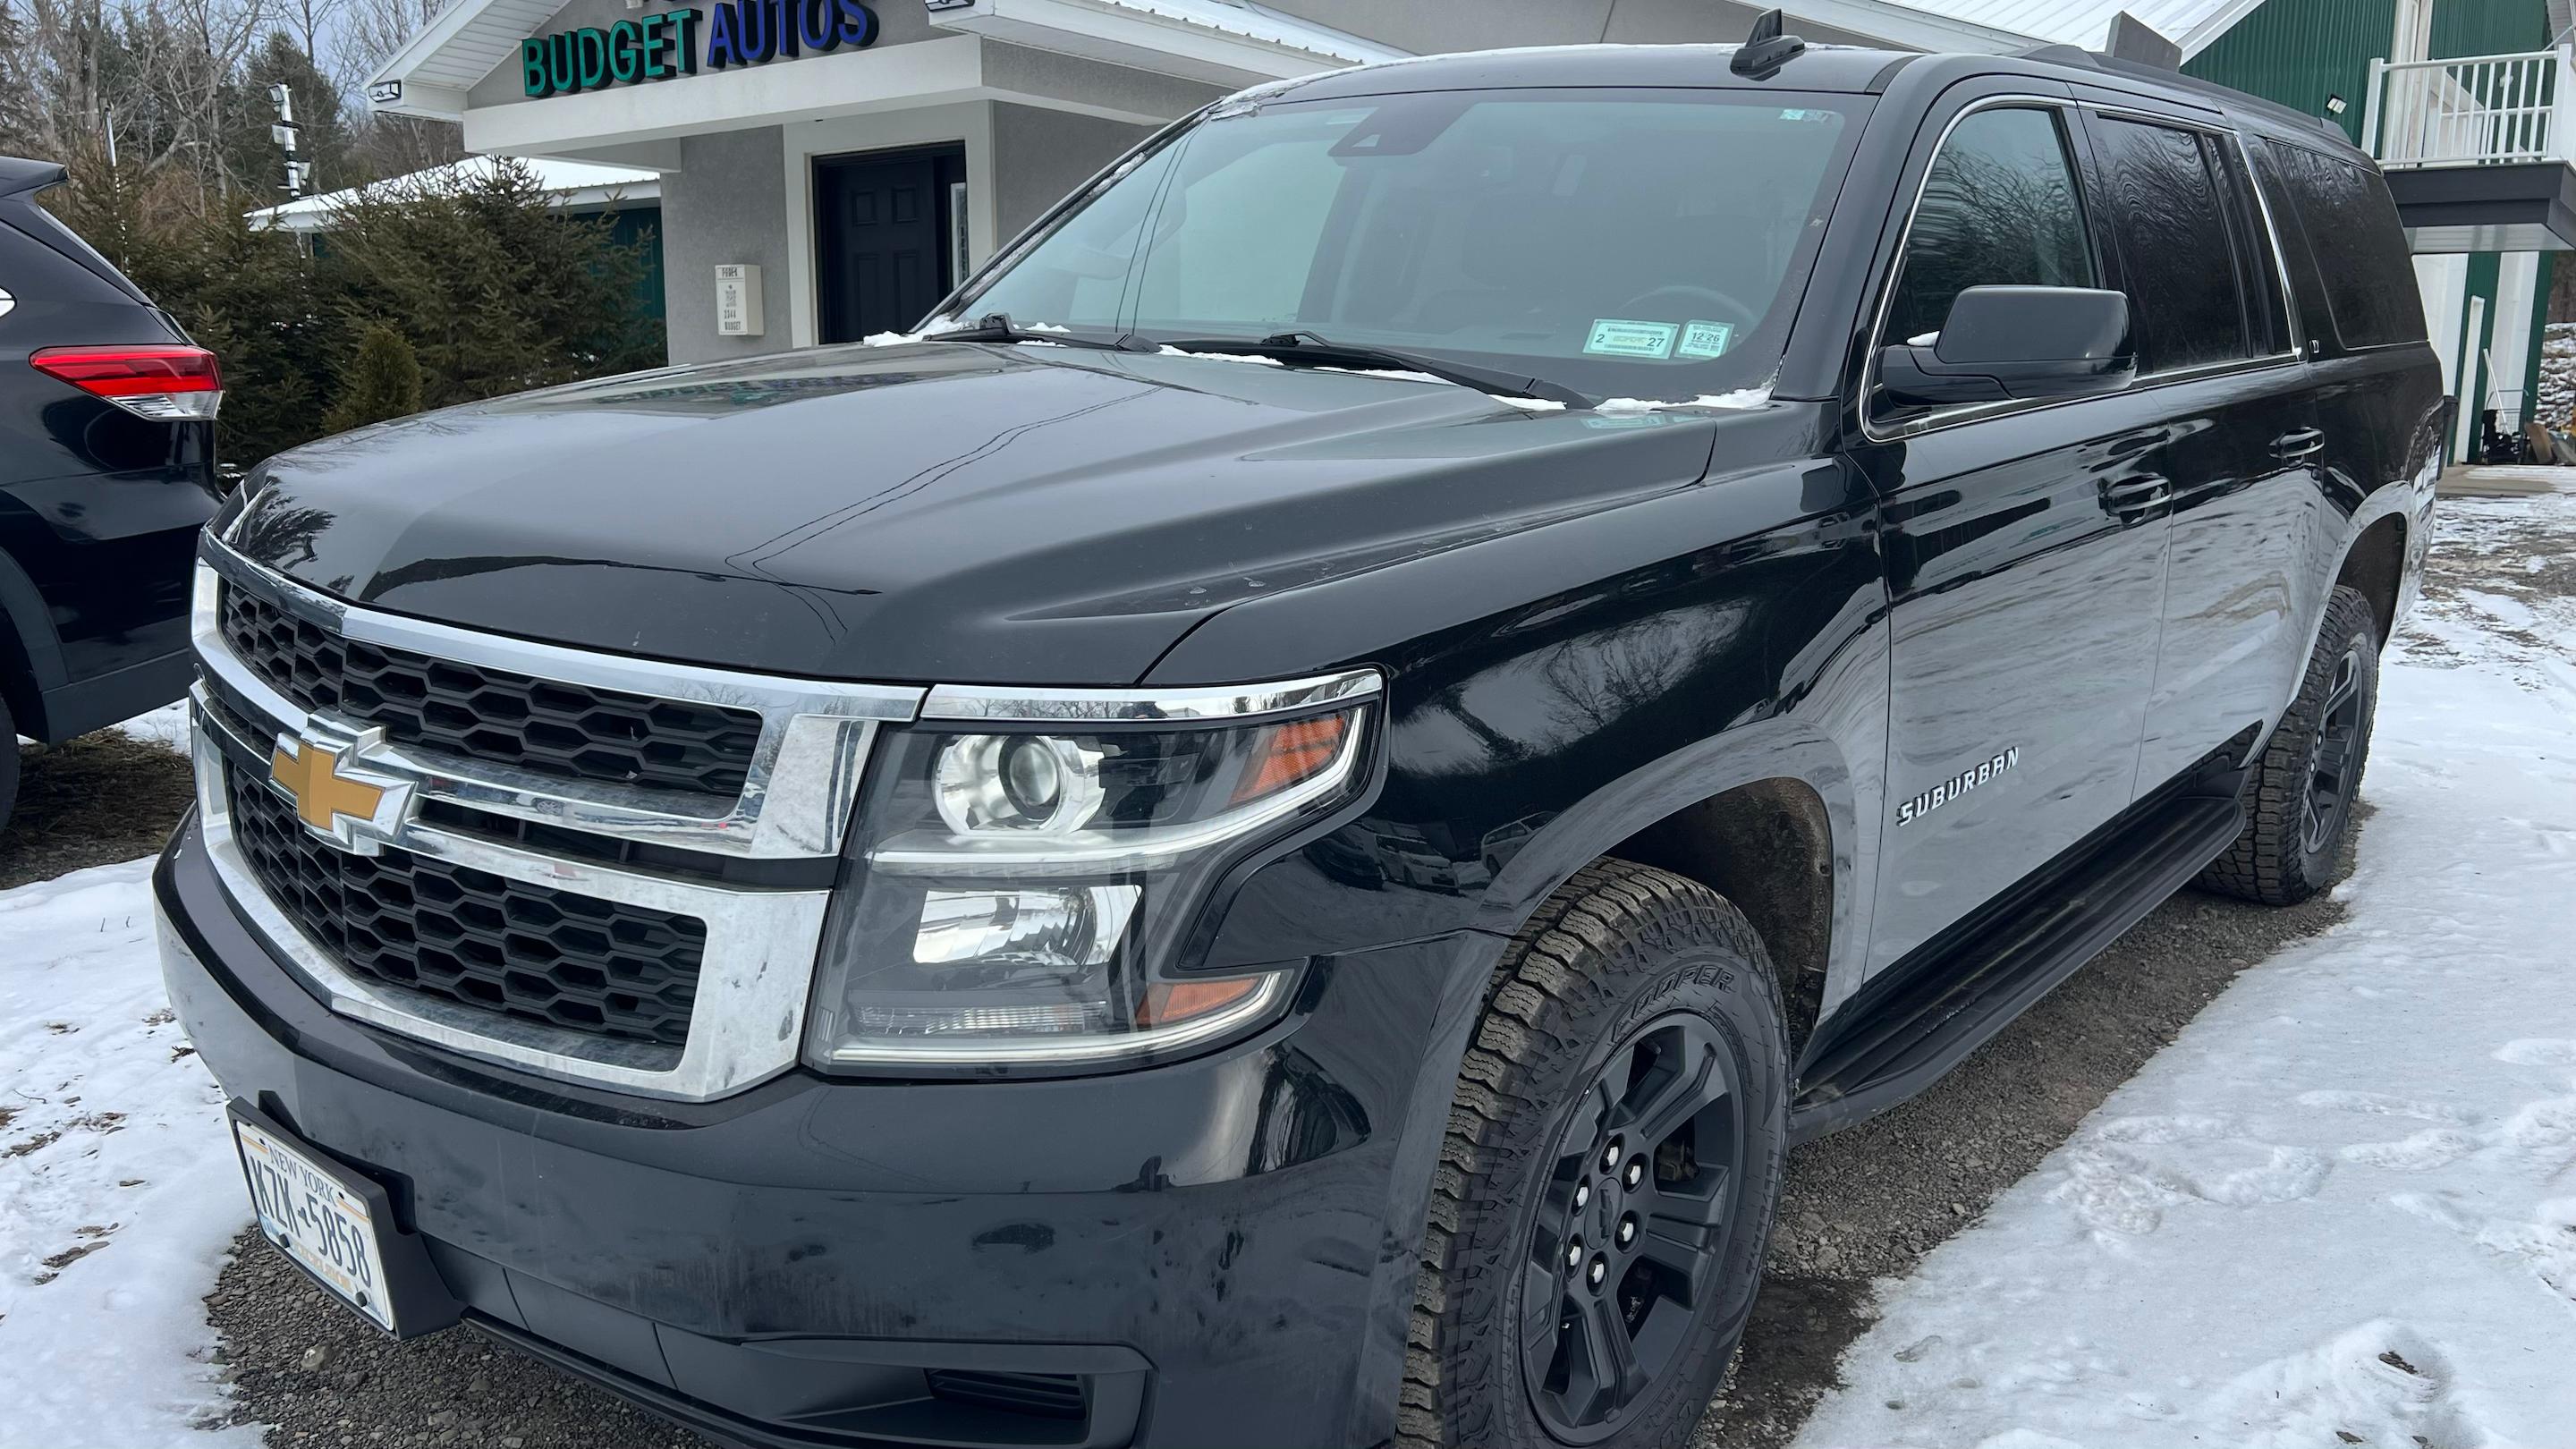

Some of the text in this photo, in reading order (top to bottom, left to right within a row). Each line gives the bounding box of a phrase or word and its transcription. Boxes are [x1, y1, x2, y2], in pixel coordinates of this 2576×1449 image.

[521, 0, 879, 97] BUDGET AUTOS
[1596, 334, 1606, 343] 2
[1647, 336, 1665, 348] 27
[1896, 746, 2020, 827] SUBURBAN
[267, 1144, 338, 1208] NEW YORK
